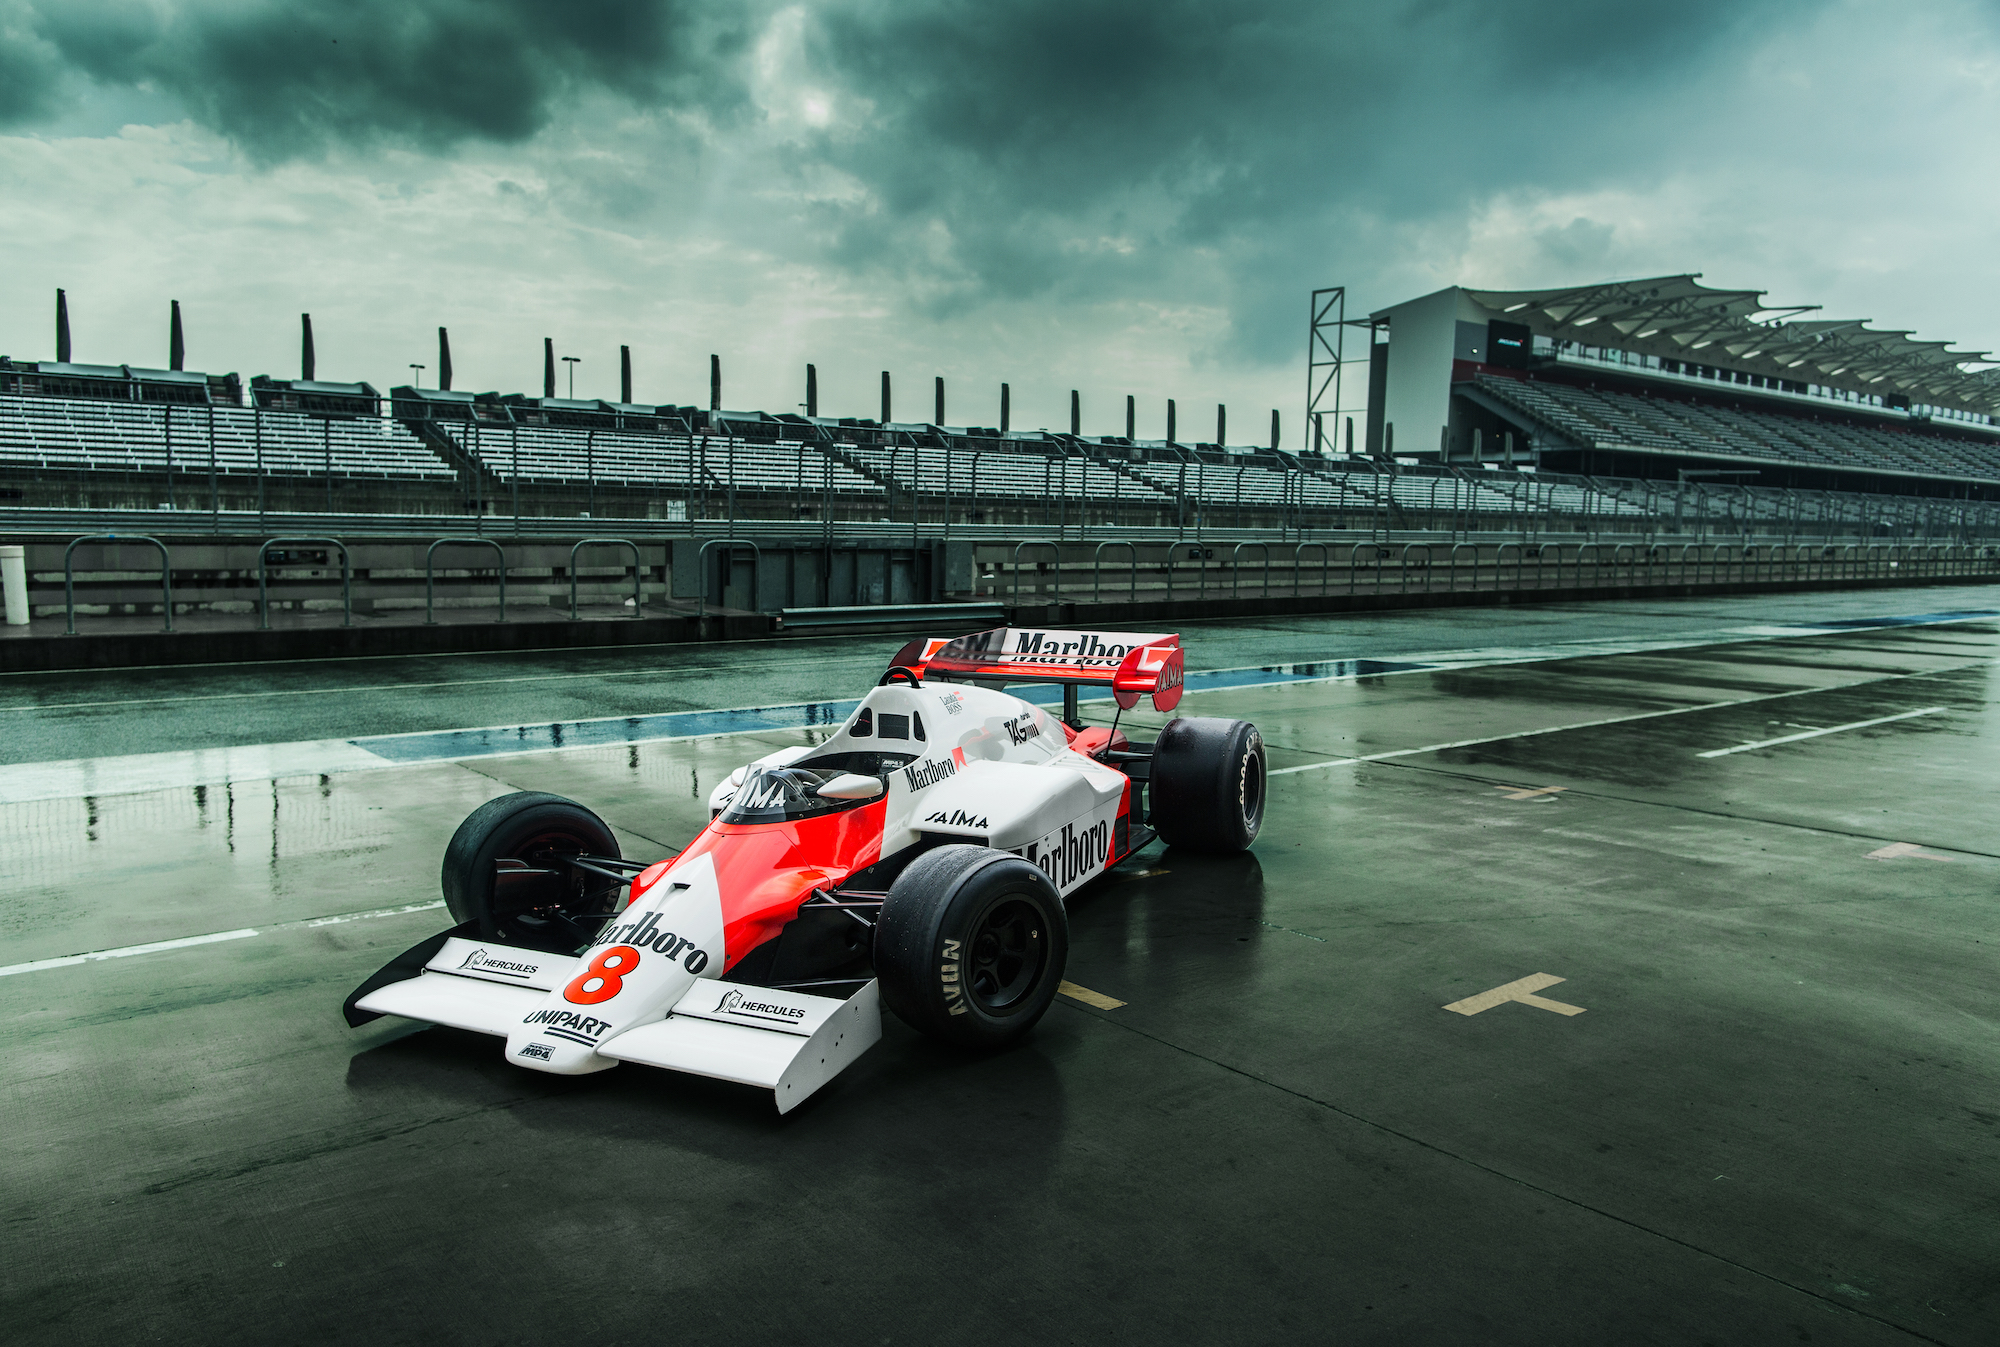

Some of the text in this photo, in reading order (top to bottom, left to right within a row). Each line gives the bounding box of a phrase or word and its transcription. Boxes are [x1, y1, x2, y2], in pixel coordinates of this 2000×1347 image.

[1003, 717, 1028, 747] TAG
[903, 758, 956, 793] Marlboro
[924, 808, 989, 829] SAIMA
[590, 911, 709, 975] arlboro
[482, 958, 539, 974] HERCULES
[562, 945, 641, 1006] 8
[940, 938, 969, 1016] AVON
[522, 1009, 613, 1037] UNIPART
[740, 1000, 806, 1019] HERCULES
[521, 1047, 550, 1060] MP4
